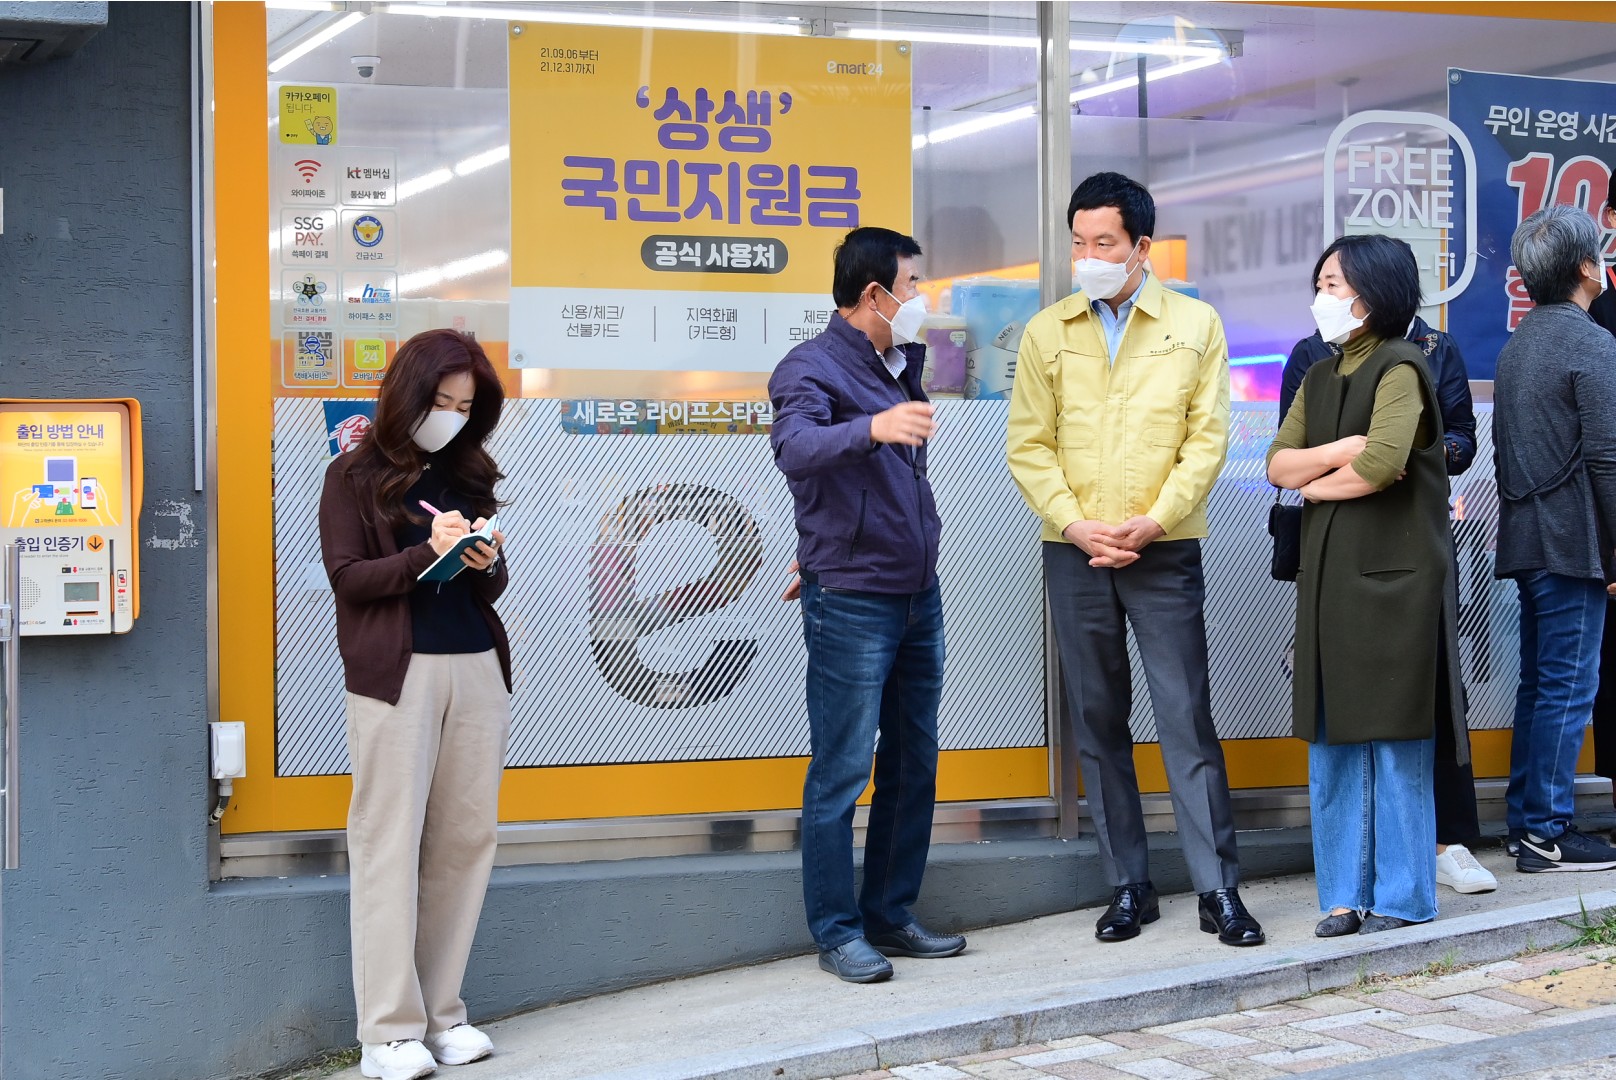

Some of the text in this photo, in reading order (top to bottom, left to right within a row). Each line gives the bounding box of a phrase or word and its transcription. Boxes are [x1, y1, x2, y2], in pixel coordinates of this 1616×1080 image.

[286, 92, 330, 103] 카카오페이
[1484, 105, 1530, 137] 무인
[1535, 109, 1579, 141] 운영
[347, 167, 390, 179] kt 멤버십
[1348, 145, 1454, 187] FREE
[291, 189, 326, 198] 와이파이존
[561, 156, 862, 227] 국민지원금
[1348, 188, 1454, 229] ZONE
[294, 217, 324, 231] SSG
[292, 250, 313, 259] 쓱페이
[356, 252, 384, 260] 긴급신고
[655, 241, 776, 269] 공식 사용처
[348, 313, 375, 321] 하이패스
[561, 304, 625, 320] 신용/체크/
[686, 308, 738, 323] 지역화폐
[803, 310, 834, 325] 제로
[566, 323, 619, 338] 선불카드
[998, 325, 1014, 341] NEW
[363, 352, 379, 364] 24
[573, 401, 774, 426] 새로운 라이프스타일
[16, 424, 104, 439] 출입 방법 안내
[14, 536, 84, 552] 출입 인증기
